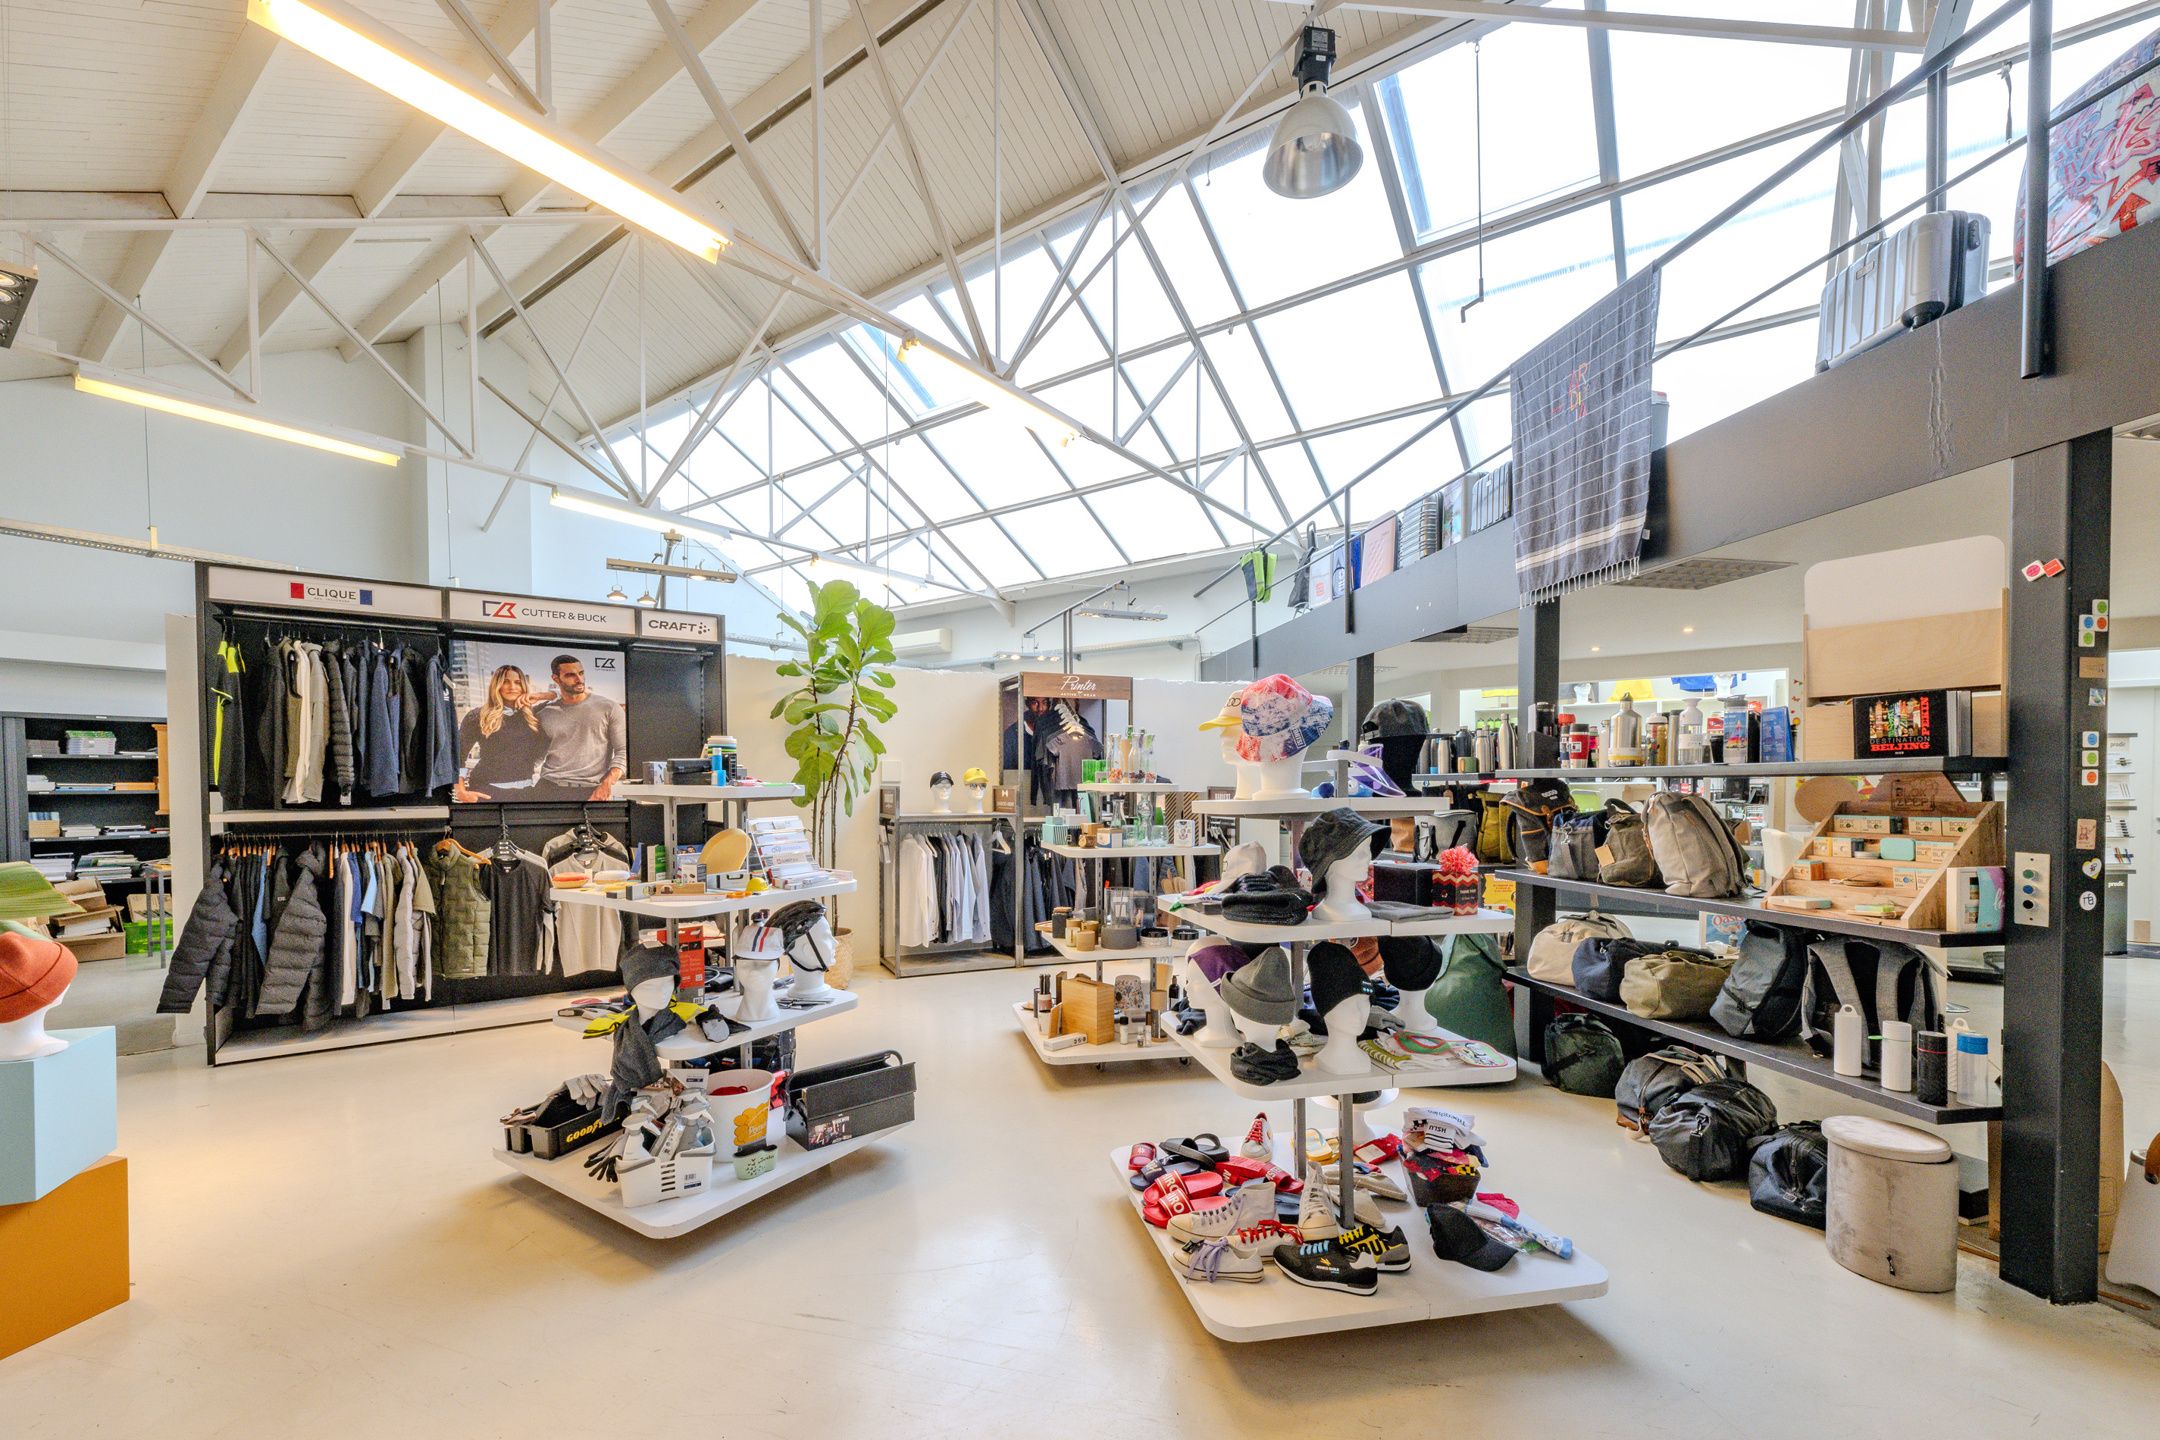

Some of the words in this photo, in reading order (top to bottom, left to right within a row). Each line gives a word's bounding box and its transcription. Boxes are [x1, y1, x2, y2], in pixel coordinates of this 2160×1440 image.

[307, 587, 357, 600] CLIQUE
[521, 607, 566, 619] CUTTER
[568, 612, 575, 620] &
[577, 613, 607, 623] BUCK
[648, 619, 697, 633] CRAFT
[1920, 696, 1931, 736] PEKIN
[1869, 735, 1931, 745] DESTINATION
[1870, 741, 1931, 752] BEIJING
